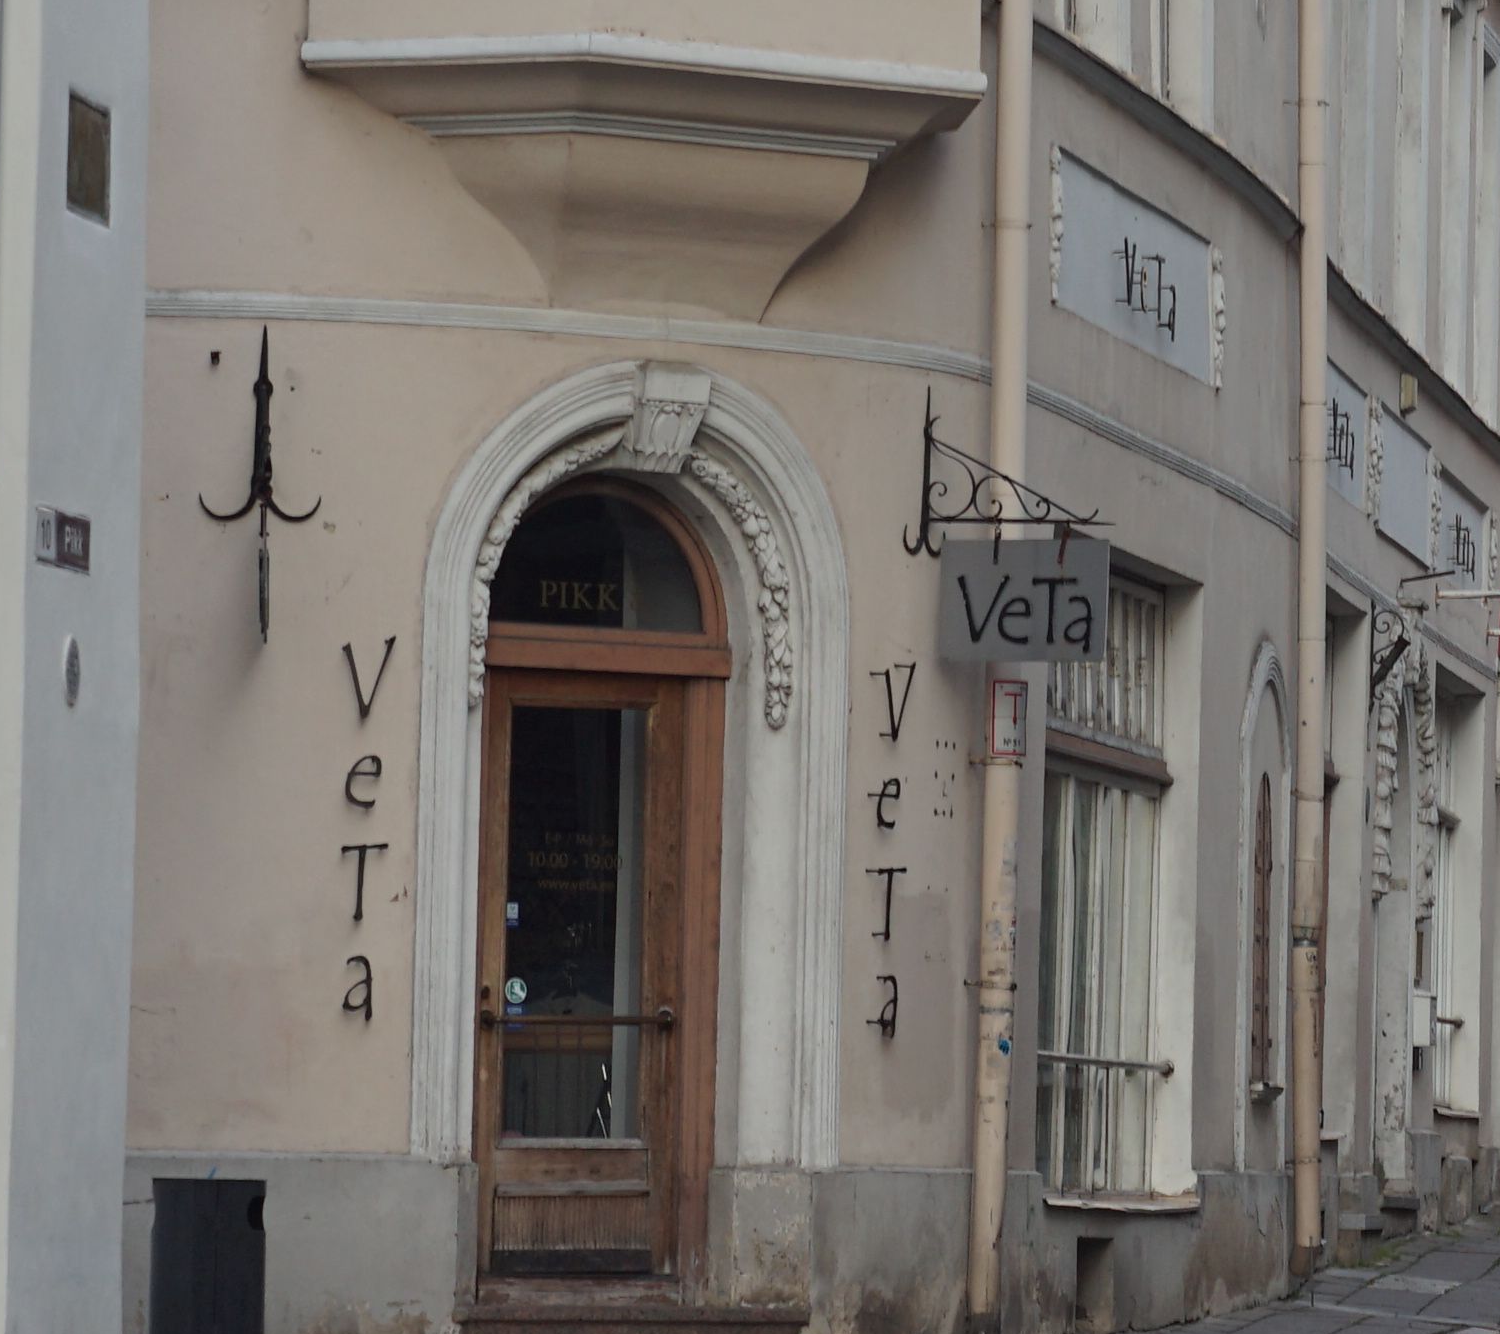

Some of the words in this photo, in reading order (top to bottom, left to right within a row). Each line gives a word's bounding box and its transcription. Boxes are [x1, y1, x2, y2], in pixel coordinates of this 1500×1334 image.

[41, 520, 52, 552] 10
[64, 524, 85, 554] Pikk
[539, 580, 621, 611] PIKK
[958, 573, 1096, 654] VeTa
